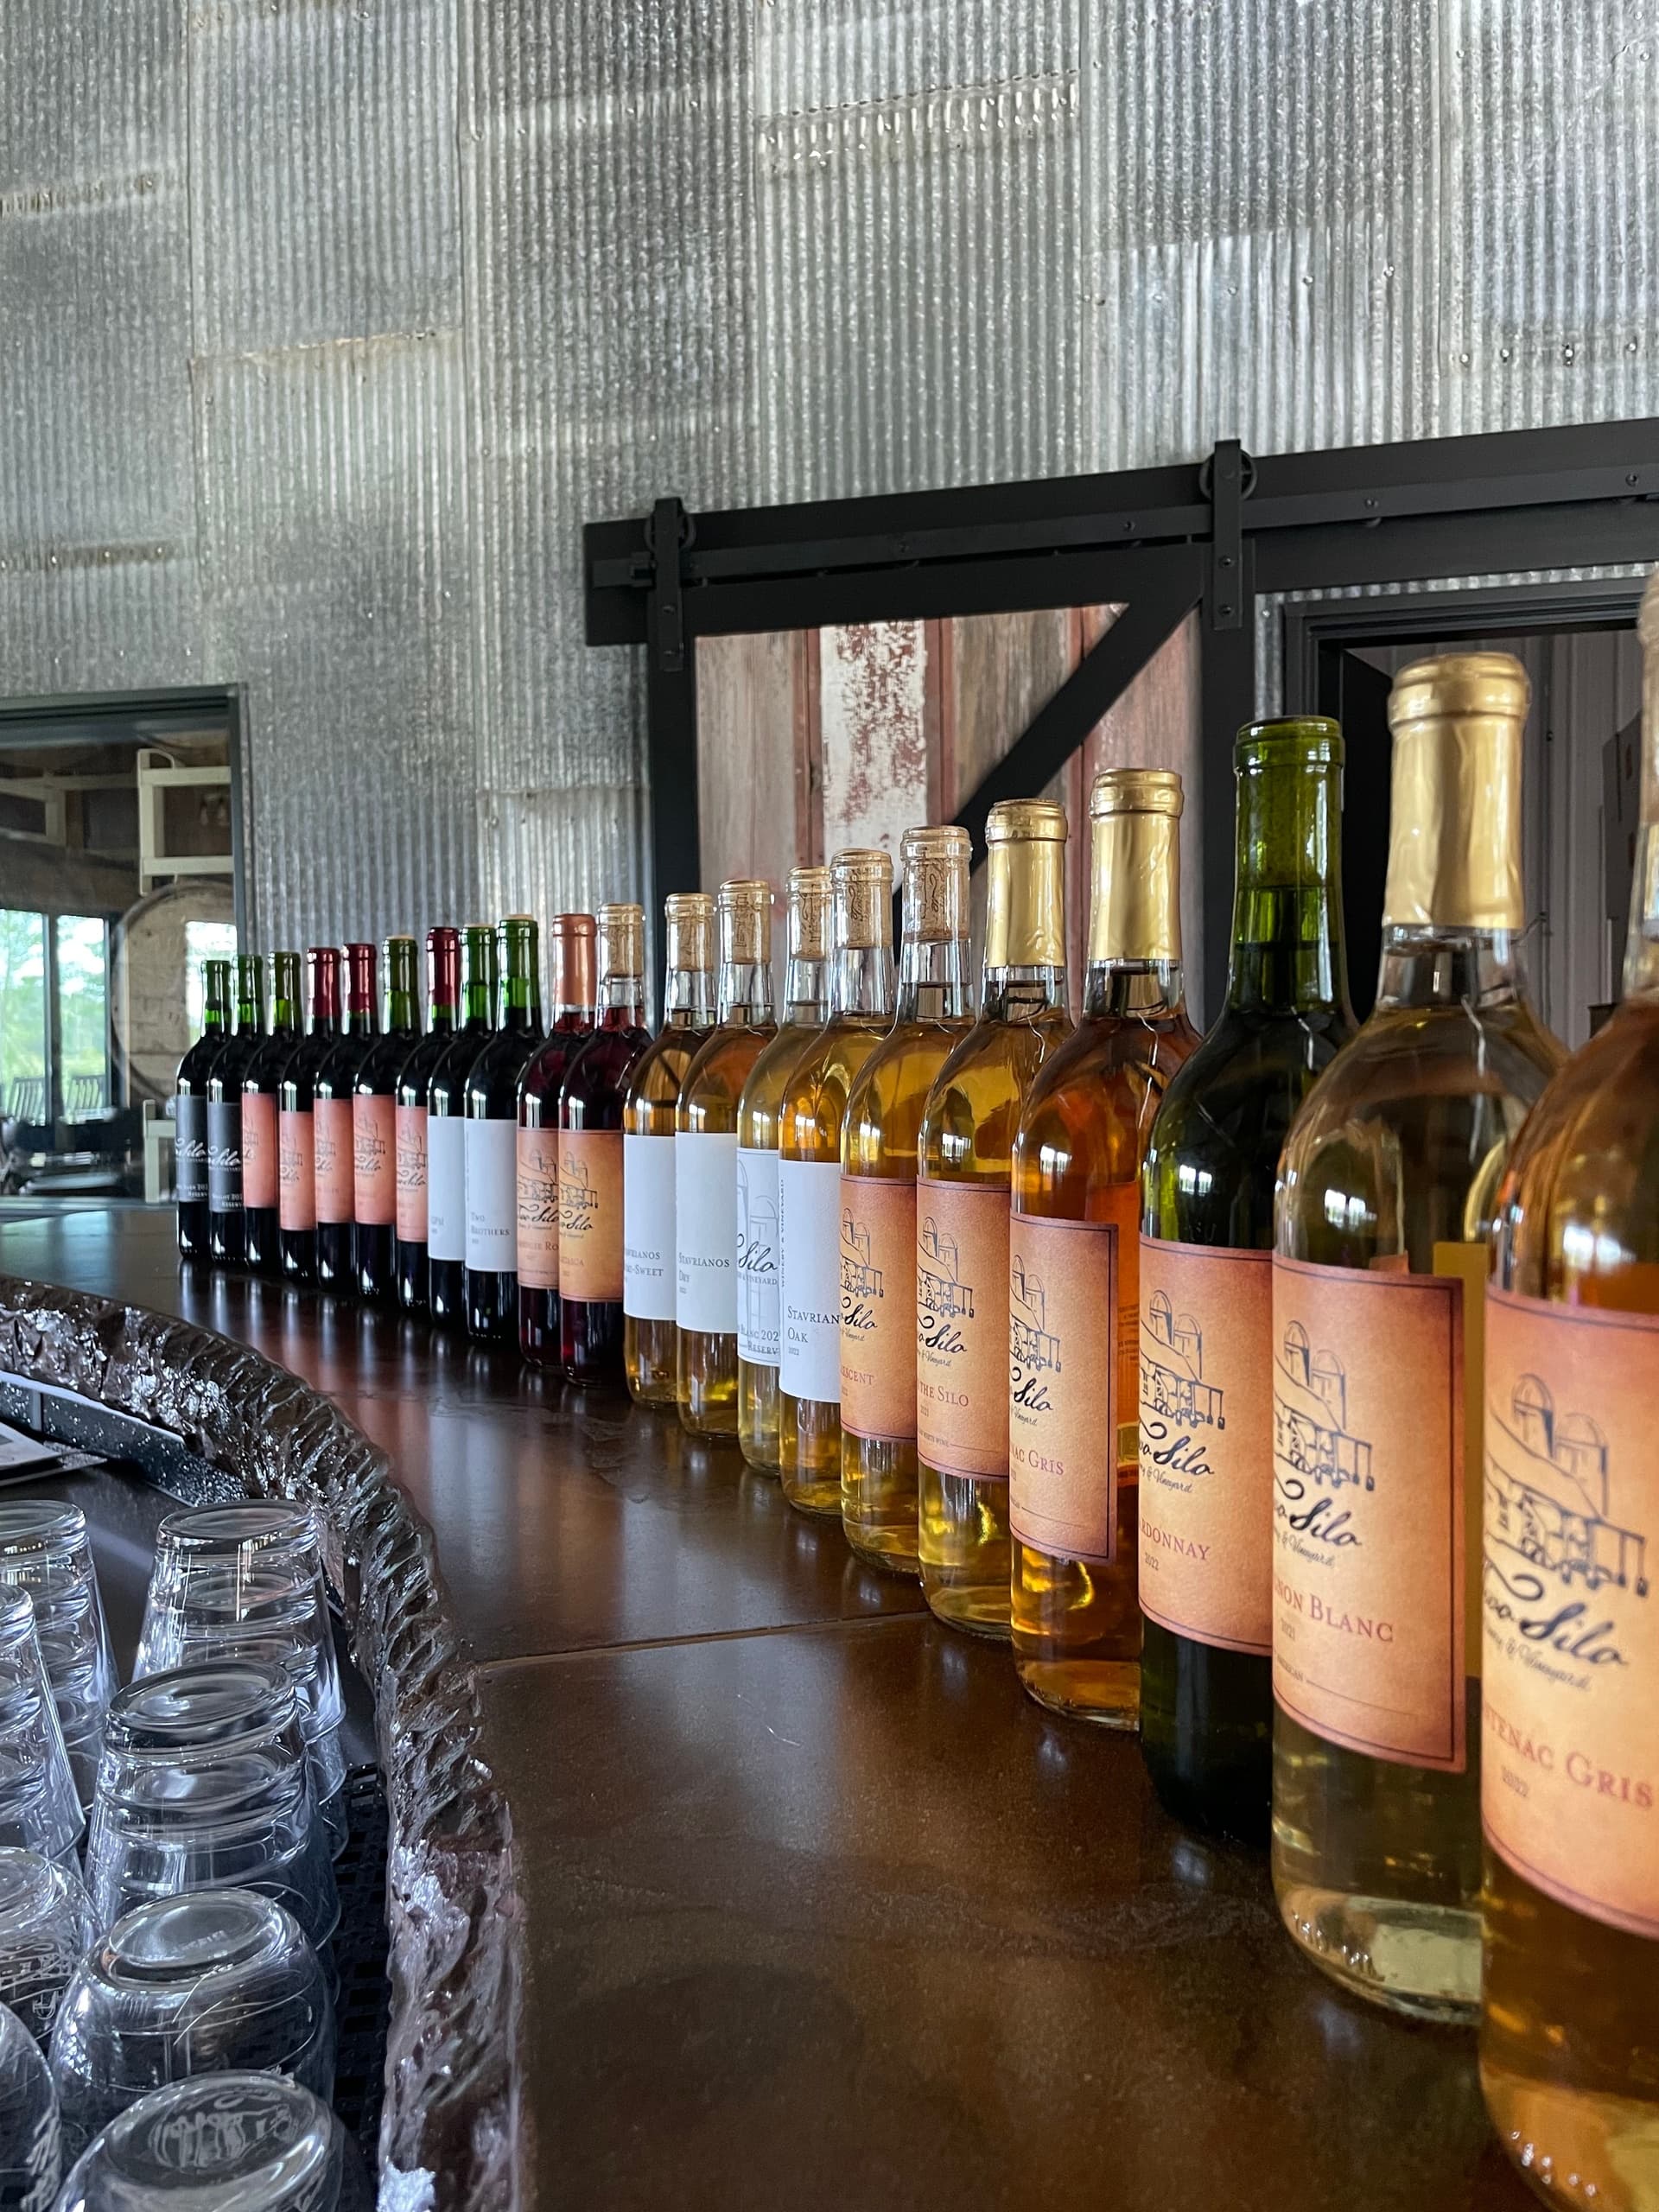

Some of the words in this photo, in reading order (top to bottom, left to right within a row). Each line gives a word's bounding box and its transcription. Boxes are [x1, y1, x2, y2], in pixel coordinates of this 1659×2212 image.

[739, 1241, 779, 1273] Silo
[788, 1306, 840, 1325] STAVRIAN
[844, 1303, 879, 1330] Silo
[760, 1330, 779, 1342] 202
[788, 1327, 809, 1344] OAK
[925, 1323, 968, 1354] Silo
[840, 1365, 874, 1385] ESCENT
[920, 1381, 935, 1399] THE
[938, 1385, 969, 1408] SILO
[1014, 1377, 1054, 1411] Silo
[1028, 1450, 1065, 1476] GRIS
[1154, 1435, 1215, 1476] Silo
[1289, 1497, 1363, 1548] Silo
[1140, 1518, 1211, 1560] RDONNAY
[1310, 1593, 1394, 1643] BLANC
[1519, 1603, 1629, 1666] Silo
[1566, 1751, 1654, 1809] GRIS
